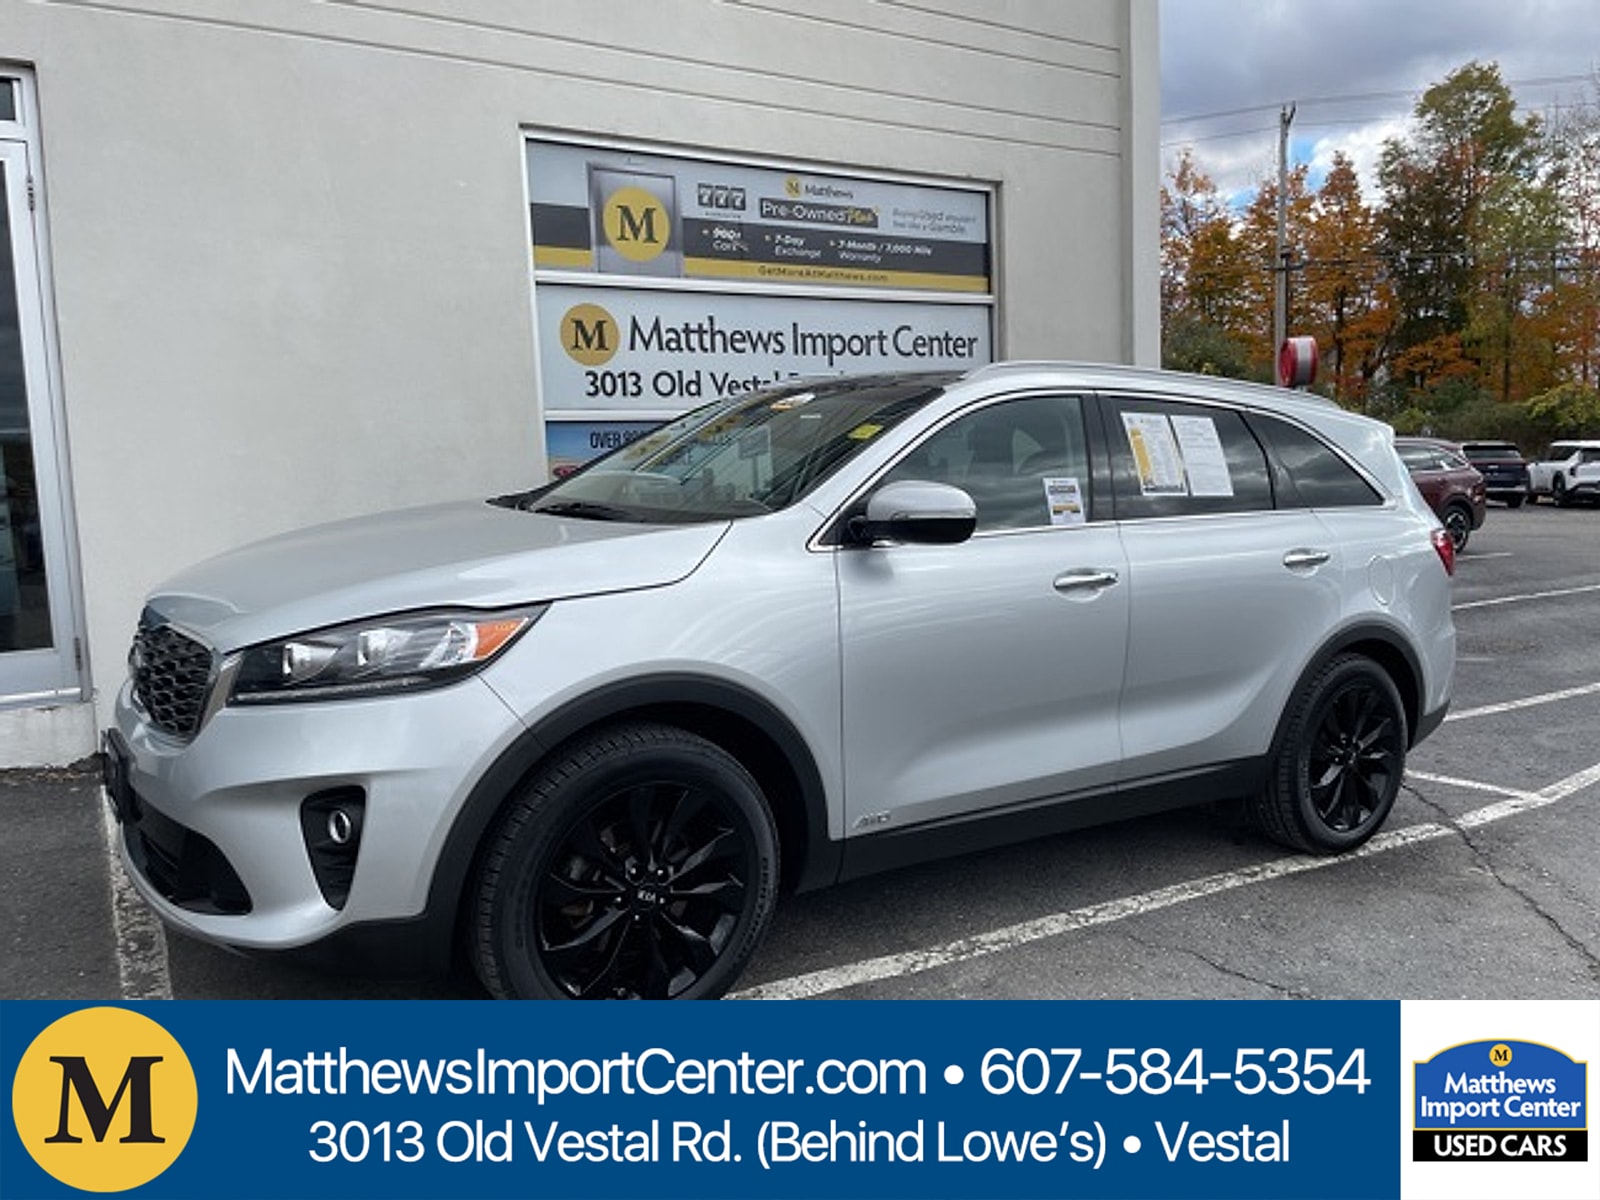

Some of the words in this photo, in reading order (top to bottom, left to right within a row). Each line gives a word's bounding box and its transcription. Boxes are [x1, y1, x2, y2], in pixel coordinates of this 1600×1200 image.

[805, 184, 854, 199] Matthews
[616, 204, 658, 244] M
[762, 202, 847, 221] Pre-Owned
[570, 318, 609, 352] M
[629, 316, 785, 355] Matthews
[792, 322, 887, 366] Import
[892, 325, 978, 358] Center
[585, 370, 643, 397] 3013
[653, 370, 702, 397] Old
[709, 370, 780, 396] Vest
[590, 431, 622, 449] OVER
